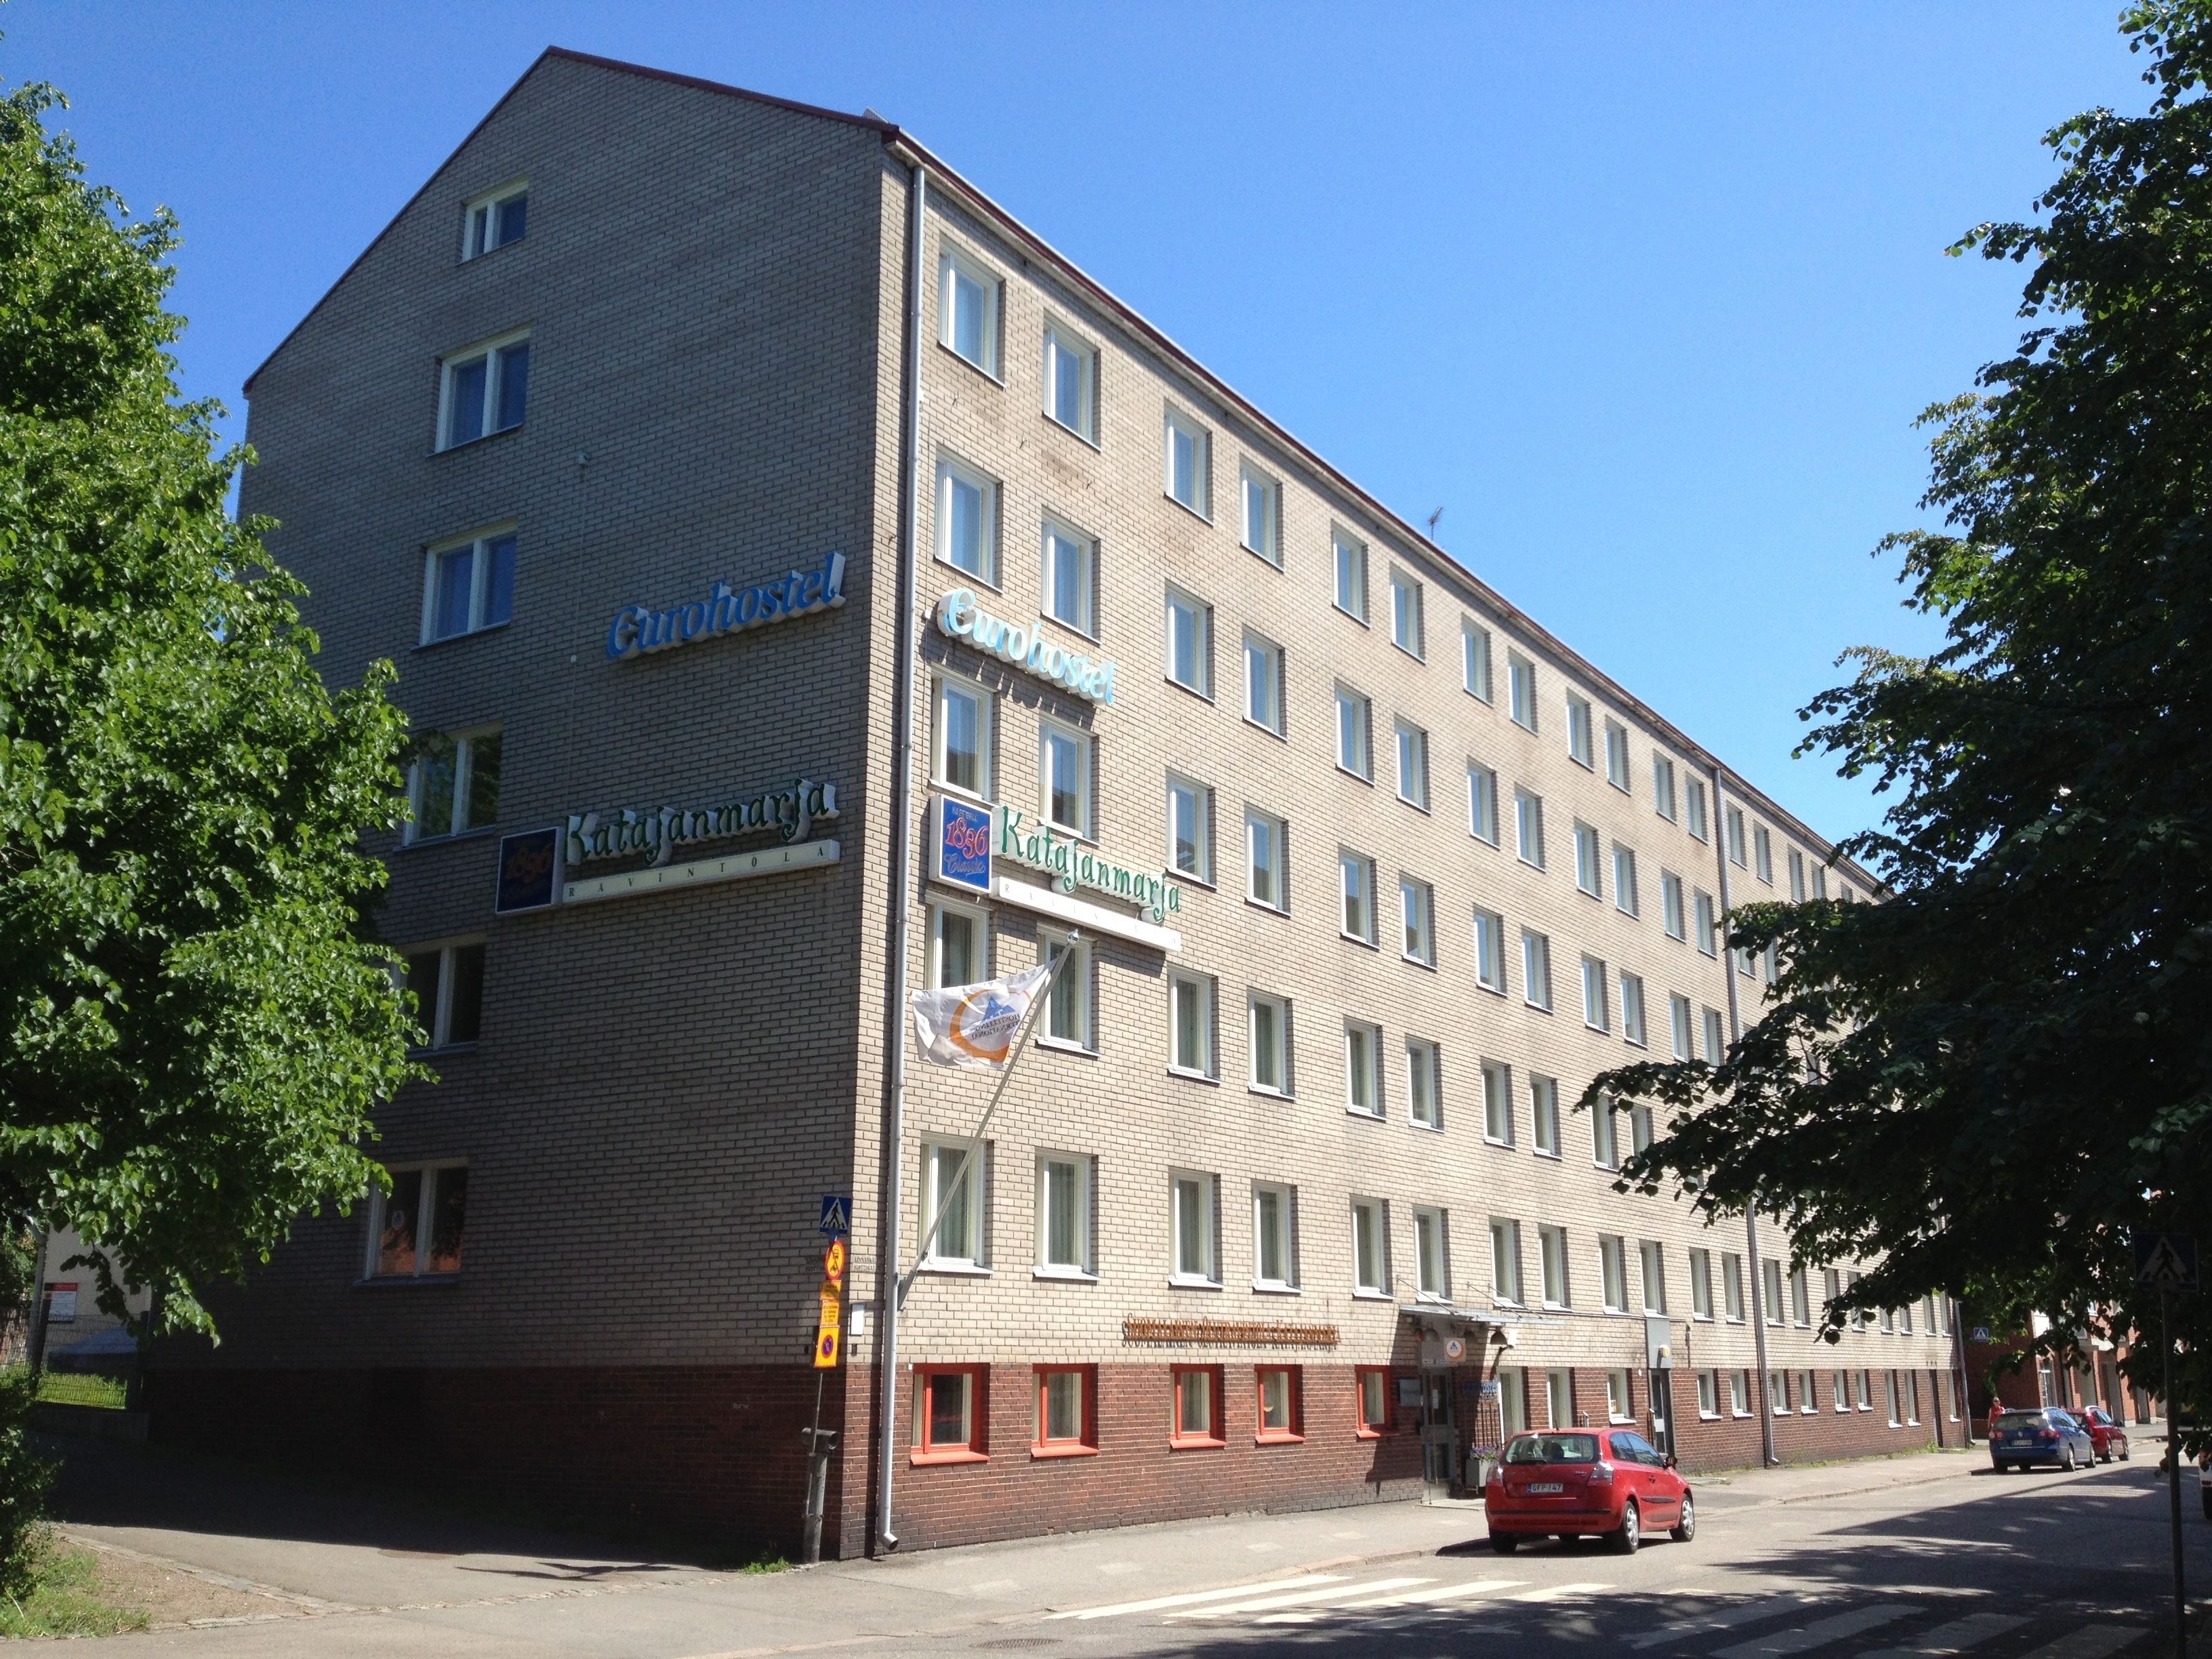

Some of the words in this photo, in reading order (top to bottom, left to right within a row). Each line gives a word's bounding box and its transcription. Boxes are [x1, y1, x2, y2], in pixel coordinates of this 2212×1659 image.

[605, 552, 844, 659] Eurohostel
[939, 588, 1116, 705] Eurohostel
[565, 779, 838, 865] Katajanmarja
[946, 818, 989, 859] 1836
[1000, 804, 1181, 922] Katajanmarja
[569, 847, 825, 897] RAVINTOLA
